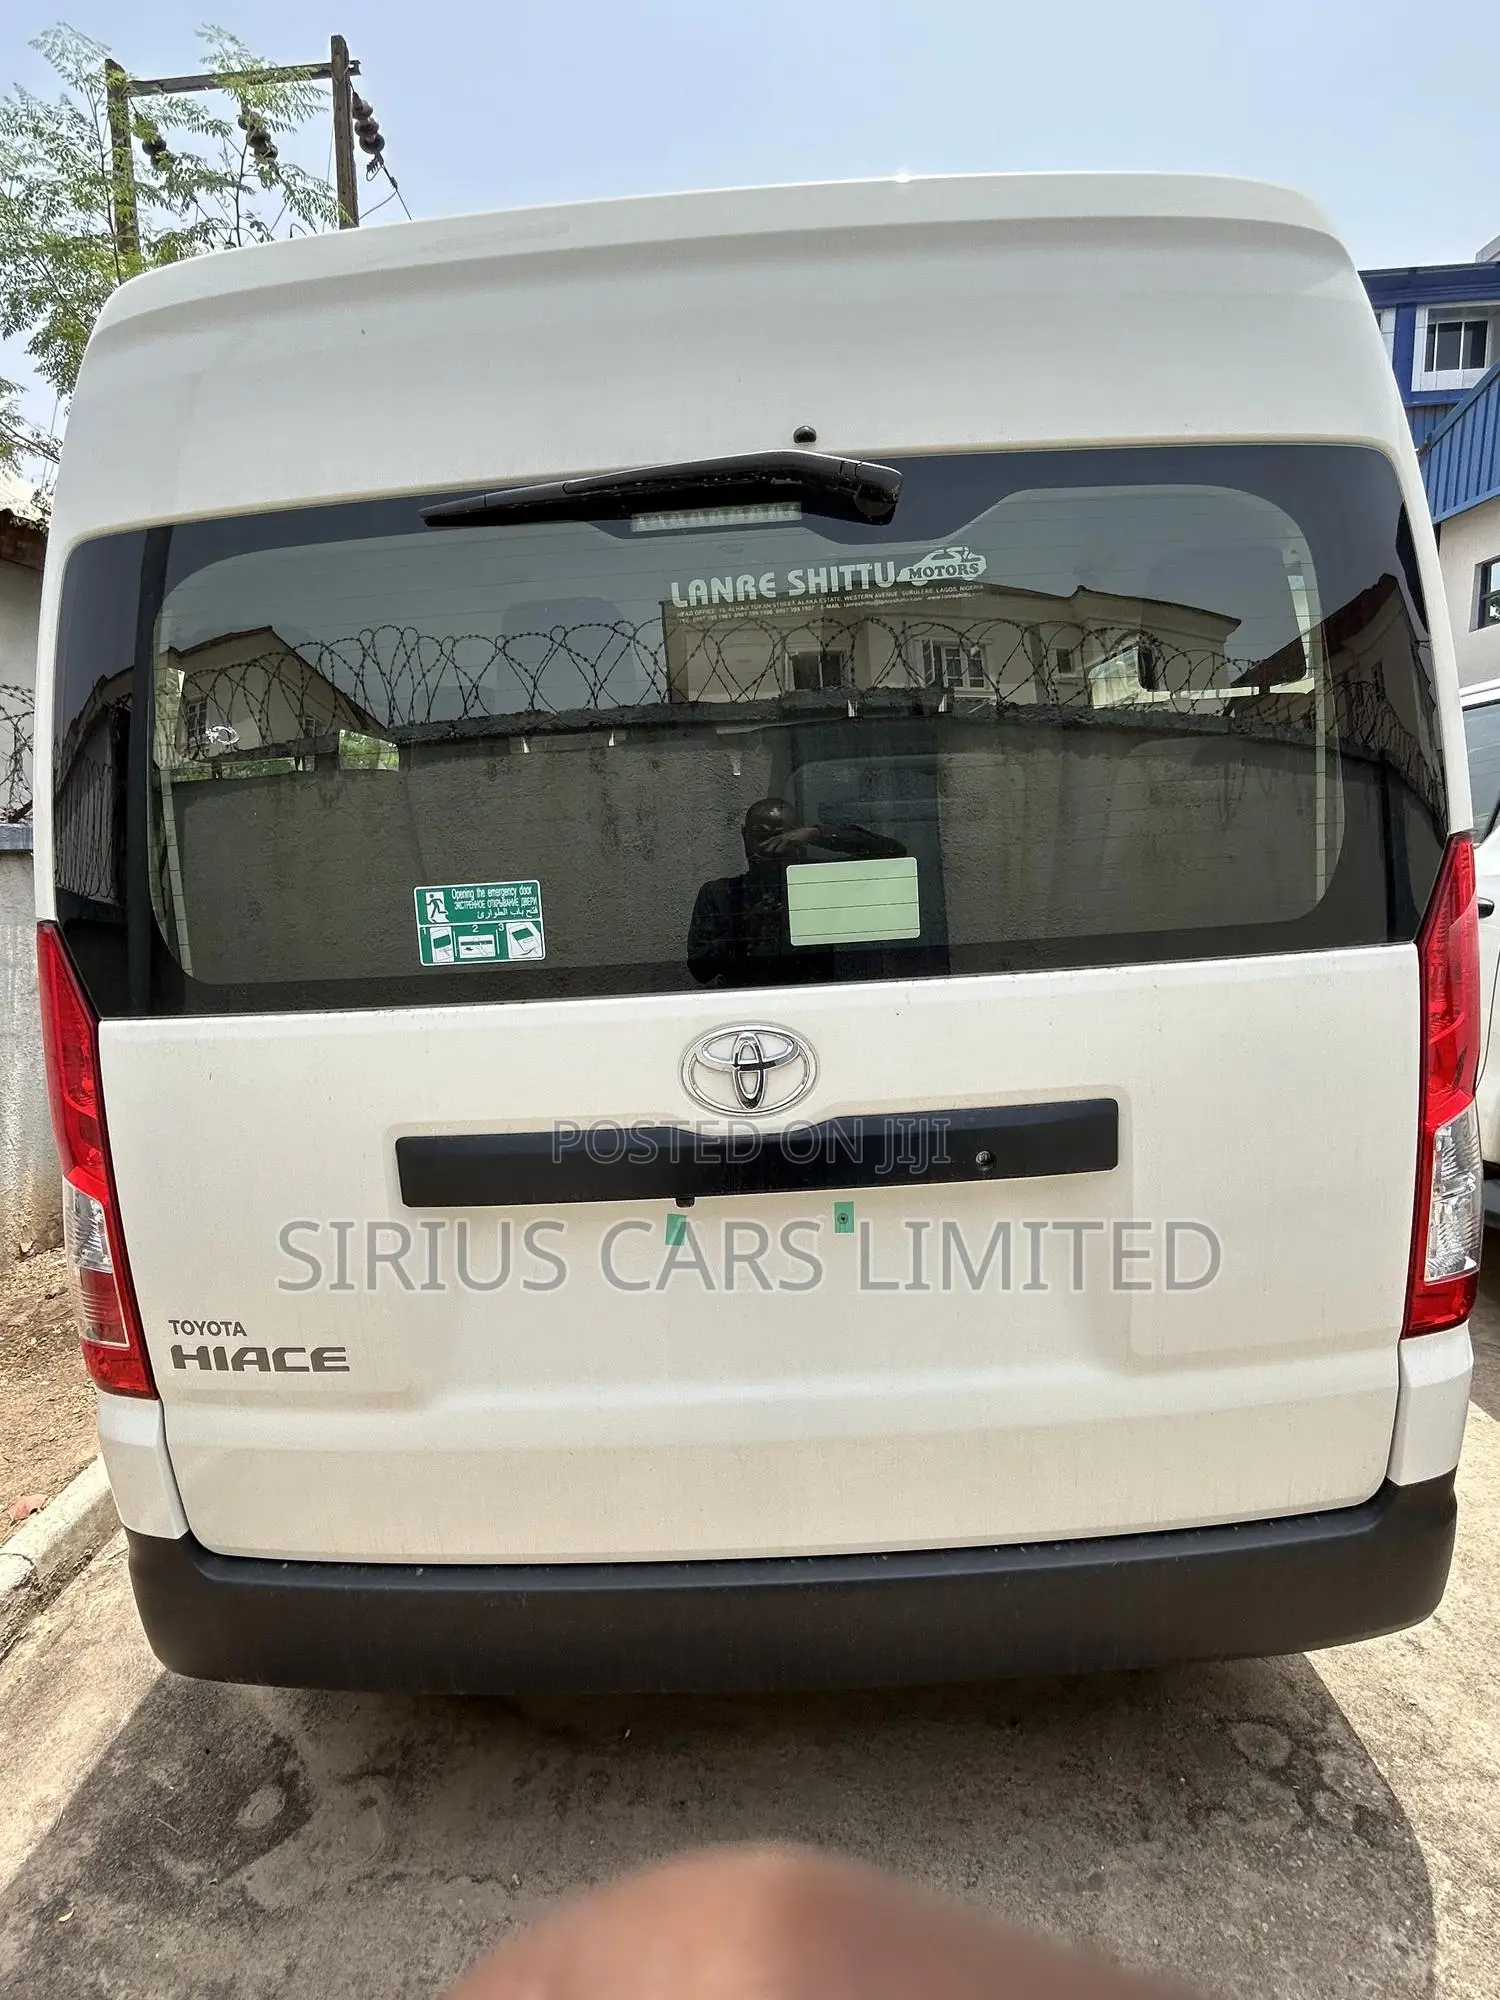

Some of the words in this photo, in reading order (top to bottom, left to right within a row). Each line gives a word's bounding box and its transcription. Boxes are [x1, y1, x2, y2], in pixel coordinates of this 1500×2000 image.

[671, 572, 776, 608] LANRE
[788, 561, 895, 597] SHITTU
[908, 563, 979, 579] MOTORS
[451, 888, 475, 900] Opening
[476, 887, 486, 897] the
[487, 887, 517, 898] emergency
[519, 885, 532, 896] door
[510, 907, 524, 917] باب
[472, 925, 479, 933] 2
[498, 924, 505, 932] 3
[168, 1320, 248, 1337] TOYOTA
[170, 1345, 350, 1372] HIACE
